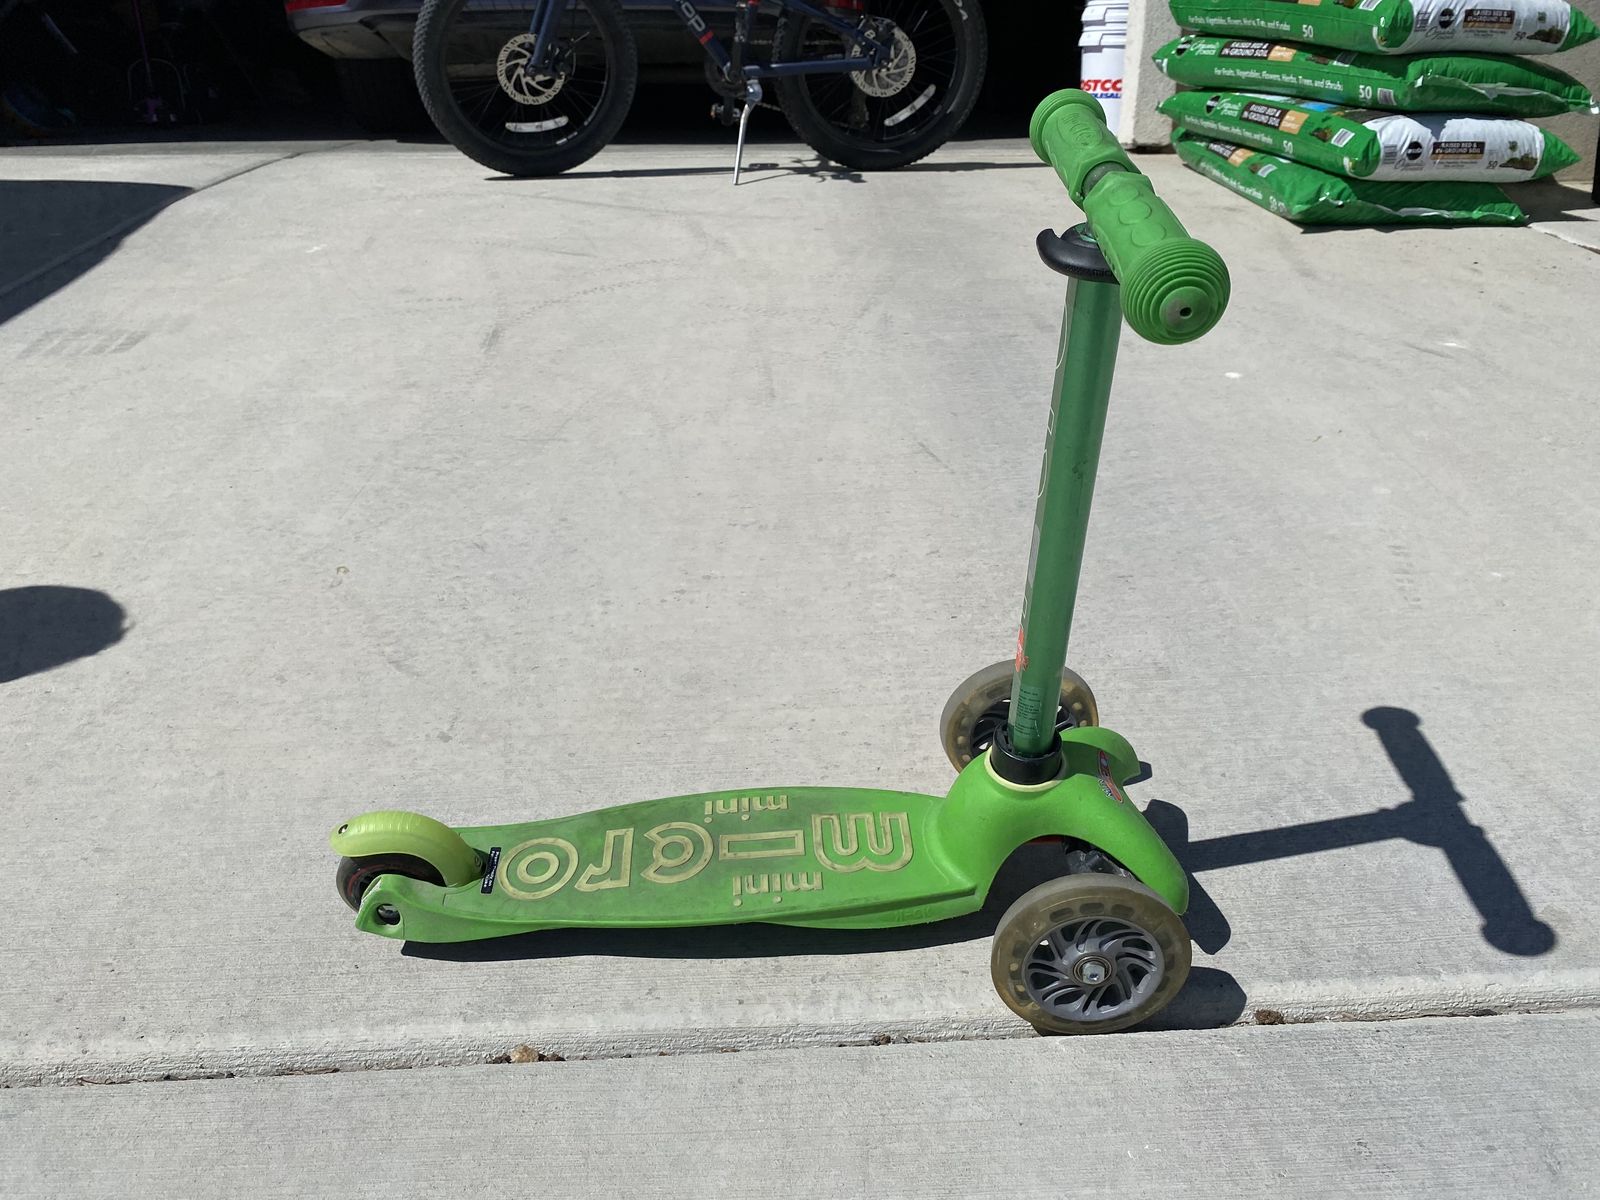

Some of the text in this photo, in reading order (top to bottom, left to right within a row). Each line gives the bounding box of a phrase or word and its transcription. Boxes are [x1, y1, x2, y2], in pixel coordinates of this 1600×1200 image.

[675, 0, 706, 32] op
[1302, 24, 1313, 38] 50
[1359, 85, 1373, 100] 50
[1283, 140, 1293, 154] 50
[703, 795, 788, 823] mini
[497, 812, 914, 901] micro
[732, 871, 823, 907] mini
